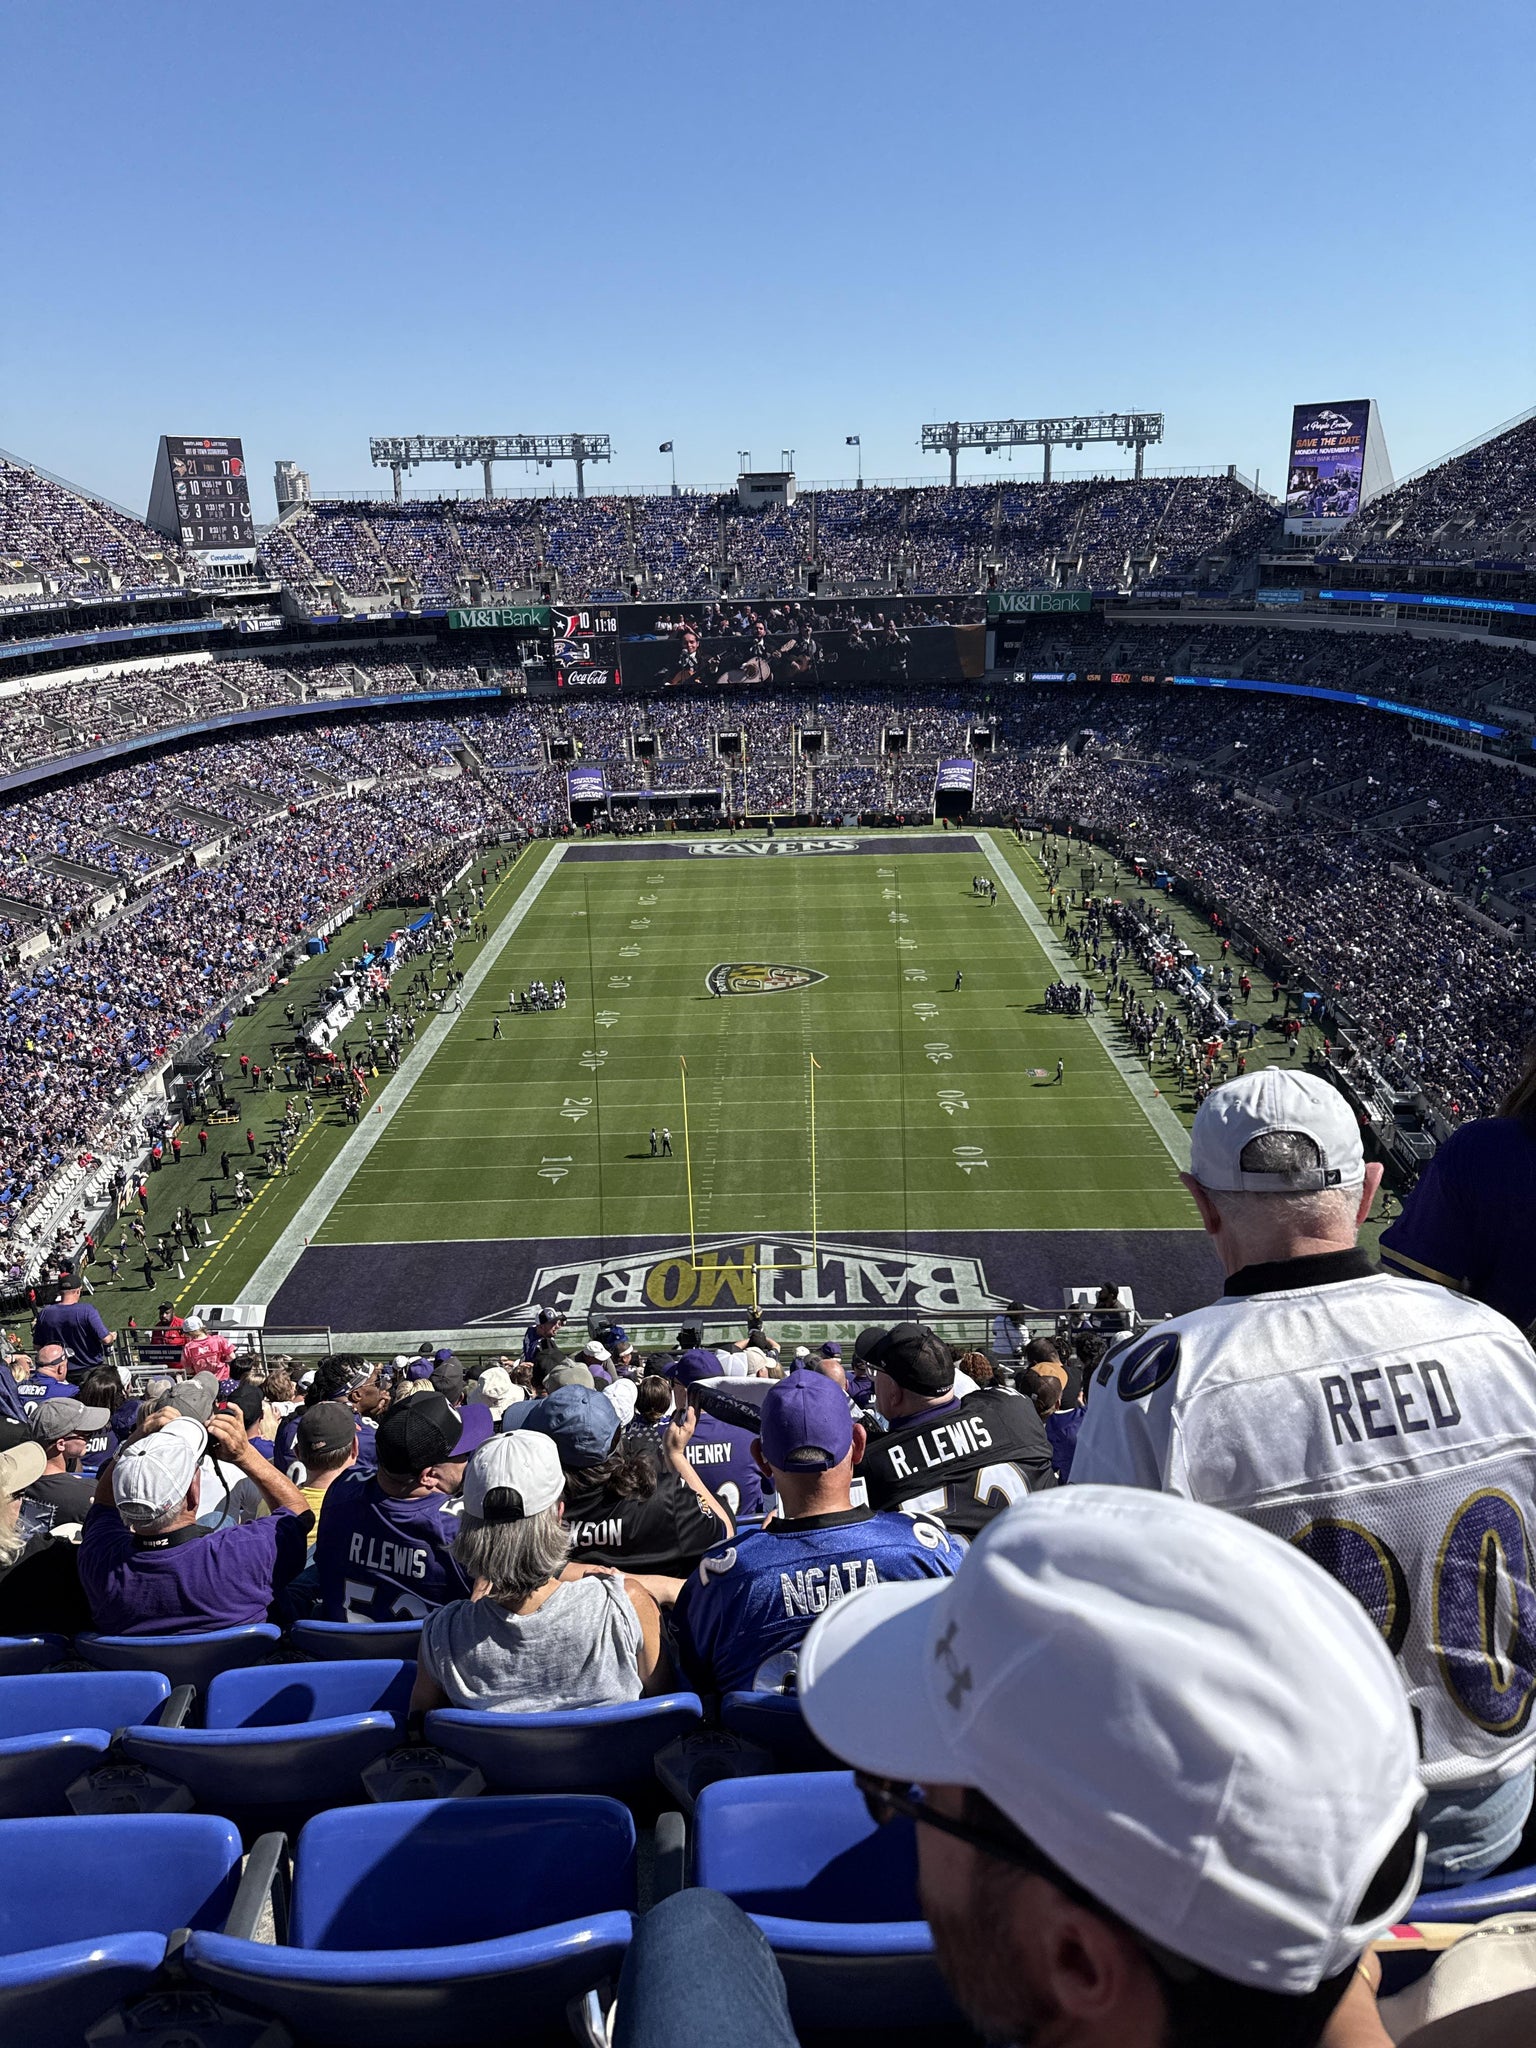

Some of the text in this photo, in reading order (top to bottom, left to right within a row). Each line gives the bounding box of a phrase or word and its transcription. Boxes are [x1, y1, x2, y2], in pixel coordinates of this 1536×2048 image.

[1296, 436, 1361, 448] SAVE THE DATE
[187, 460, 230, 475] 21 FINAL 17
[189, 480, 200, 496] 10
[226, 480, 233, 495] 0
[194, 504, 202, 518] 3
[230, 503, 235, 517] 7
[198, 526, 204, 541] 7
[232, 526, 240, 540] 3
[998, 594, 1080, 612] M&T Bank
[459, 610, 542, 628] M&T Bank
[578, 612, 590, 629] 10
[595, 618, 617, 632] 11:18
[179, 624, 200, 633] packages
[582, 642, 590, 660] 3
[456, 690, 480, 698] packages
[691, 840, 855, 855] RAVENS
[608, 976, 632, 988] 50
[903, 968, 928, 982] 50
[594, 1010, 620, 1024] 40
[912, 1003, 940, 1018] 40
[578, 1050, 608, 1067] 30
[924, 1042, 952, 1060] 30
[560, 1098, 592, 1117] 20
[936, 1090, 970, 1110] 20
[952, 1146, 988, 1168] 10
[537, 1156, 573, 1178] 10
[538, 1243, 982, 1317] BALTIMORE
[18, 1384, 47, 1396] NDREWS
[1320, 1359, 1462, 1446] REED
[686, 1442, 732, 1465] HENRY
[888, 1416, 993, 1479] R. LEWIS
[349, 1532, 428, 1579] R.LEWIS
[780, 1558, 879, 1618] NGATA
